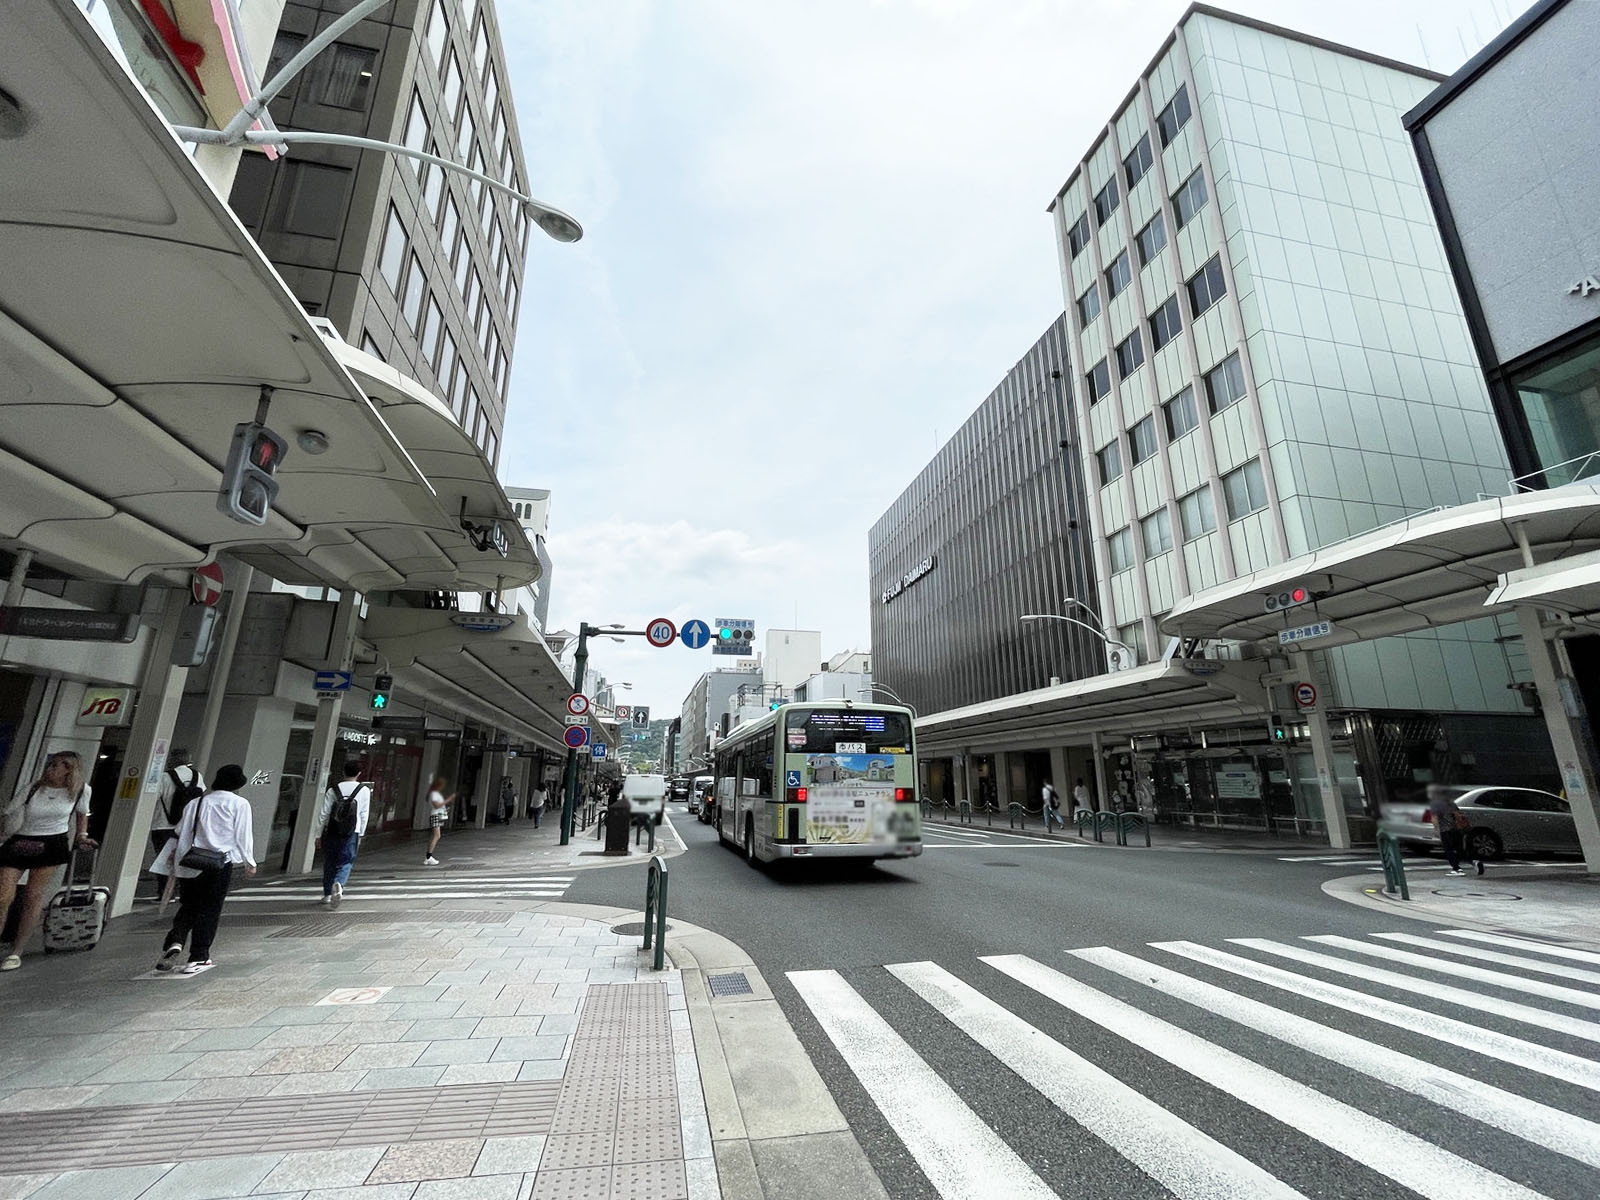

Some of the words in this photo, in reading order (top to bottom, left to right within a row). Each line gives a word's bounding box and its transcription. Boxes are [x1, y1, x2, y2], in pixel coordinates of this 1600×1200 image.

[652, 626, 671, 640] 40
[80, 697, 122, 717] JTB
[343, 731, 368, 744] LACOSTE
